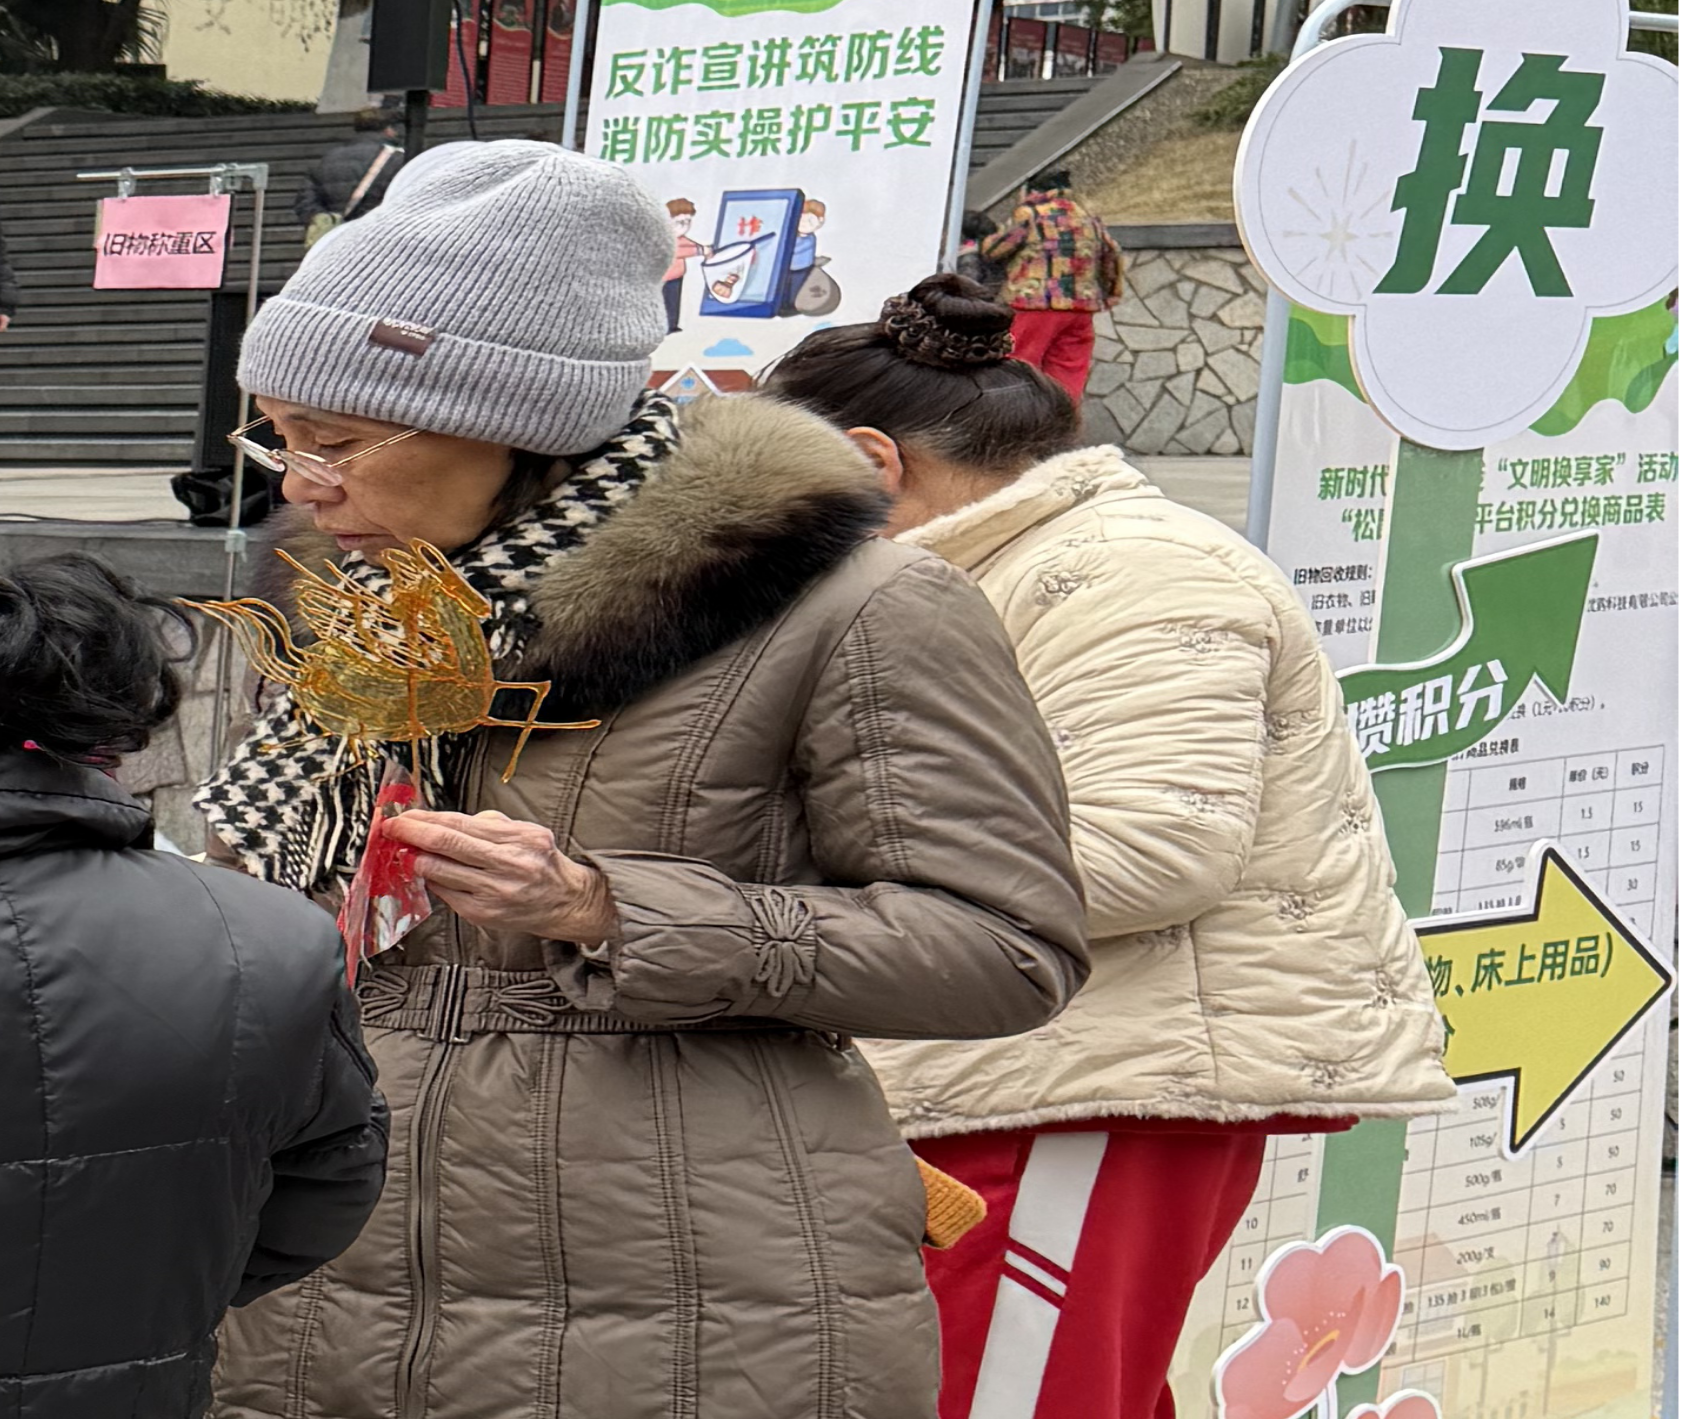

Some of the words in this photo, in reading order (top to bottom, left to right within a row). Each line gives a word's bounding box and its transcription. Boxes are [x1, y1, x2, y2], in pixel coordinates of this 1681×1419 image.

[605, 26, 944, 99] 反诈宣讲筑防线
[599, 97, 936, 164] 消防实操护平安
[1372, 46, 1606, 297] 换
[104, 231, 217, 257] 旧物称重区
[1475, 493, 1666, 535] 平台积分兑换商品表
[1245, 1216, 1259, 1230] 10
[1241, 1257, 1253, 1271] 11
[1236, 1297, 1250, 1311] 12
